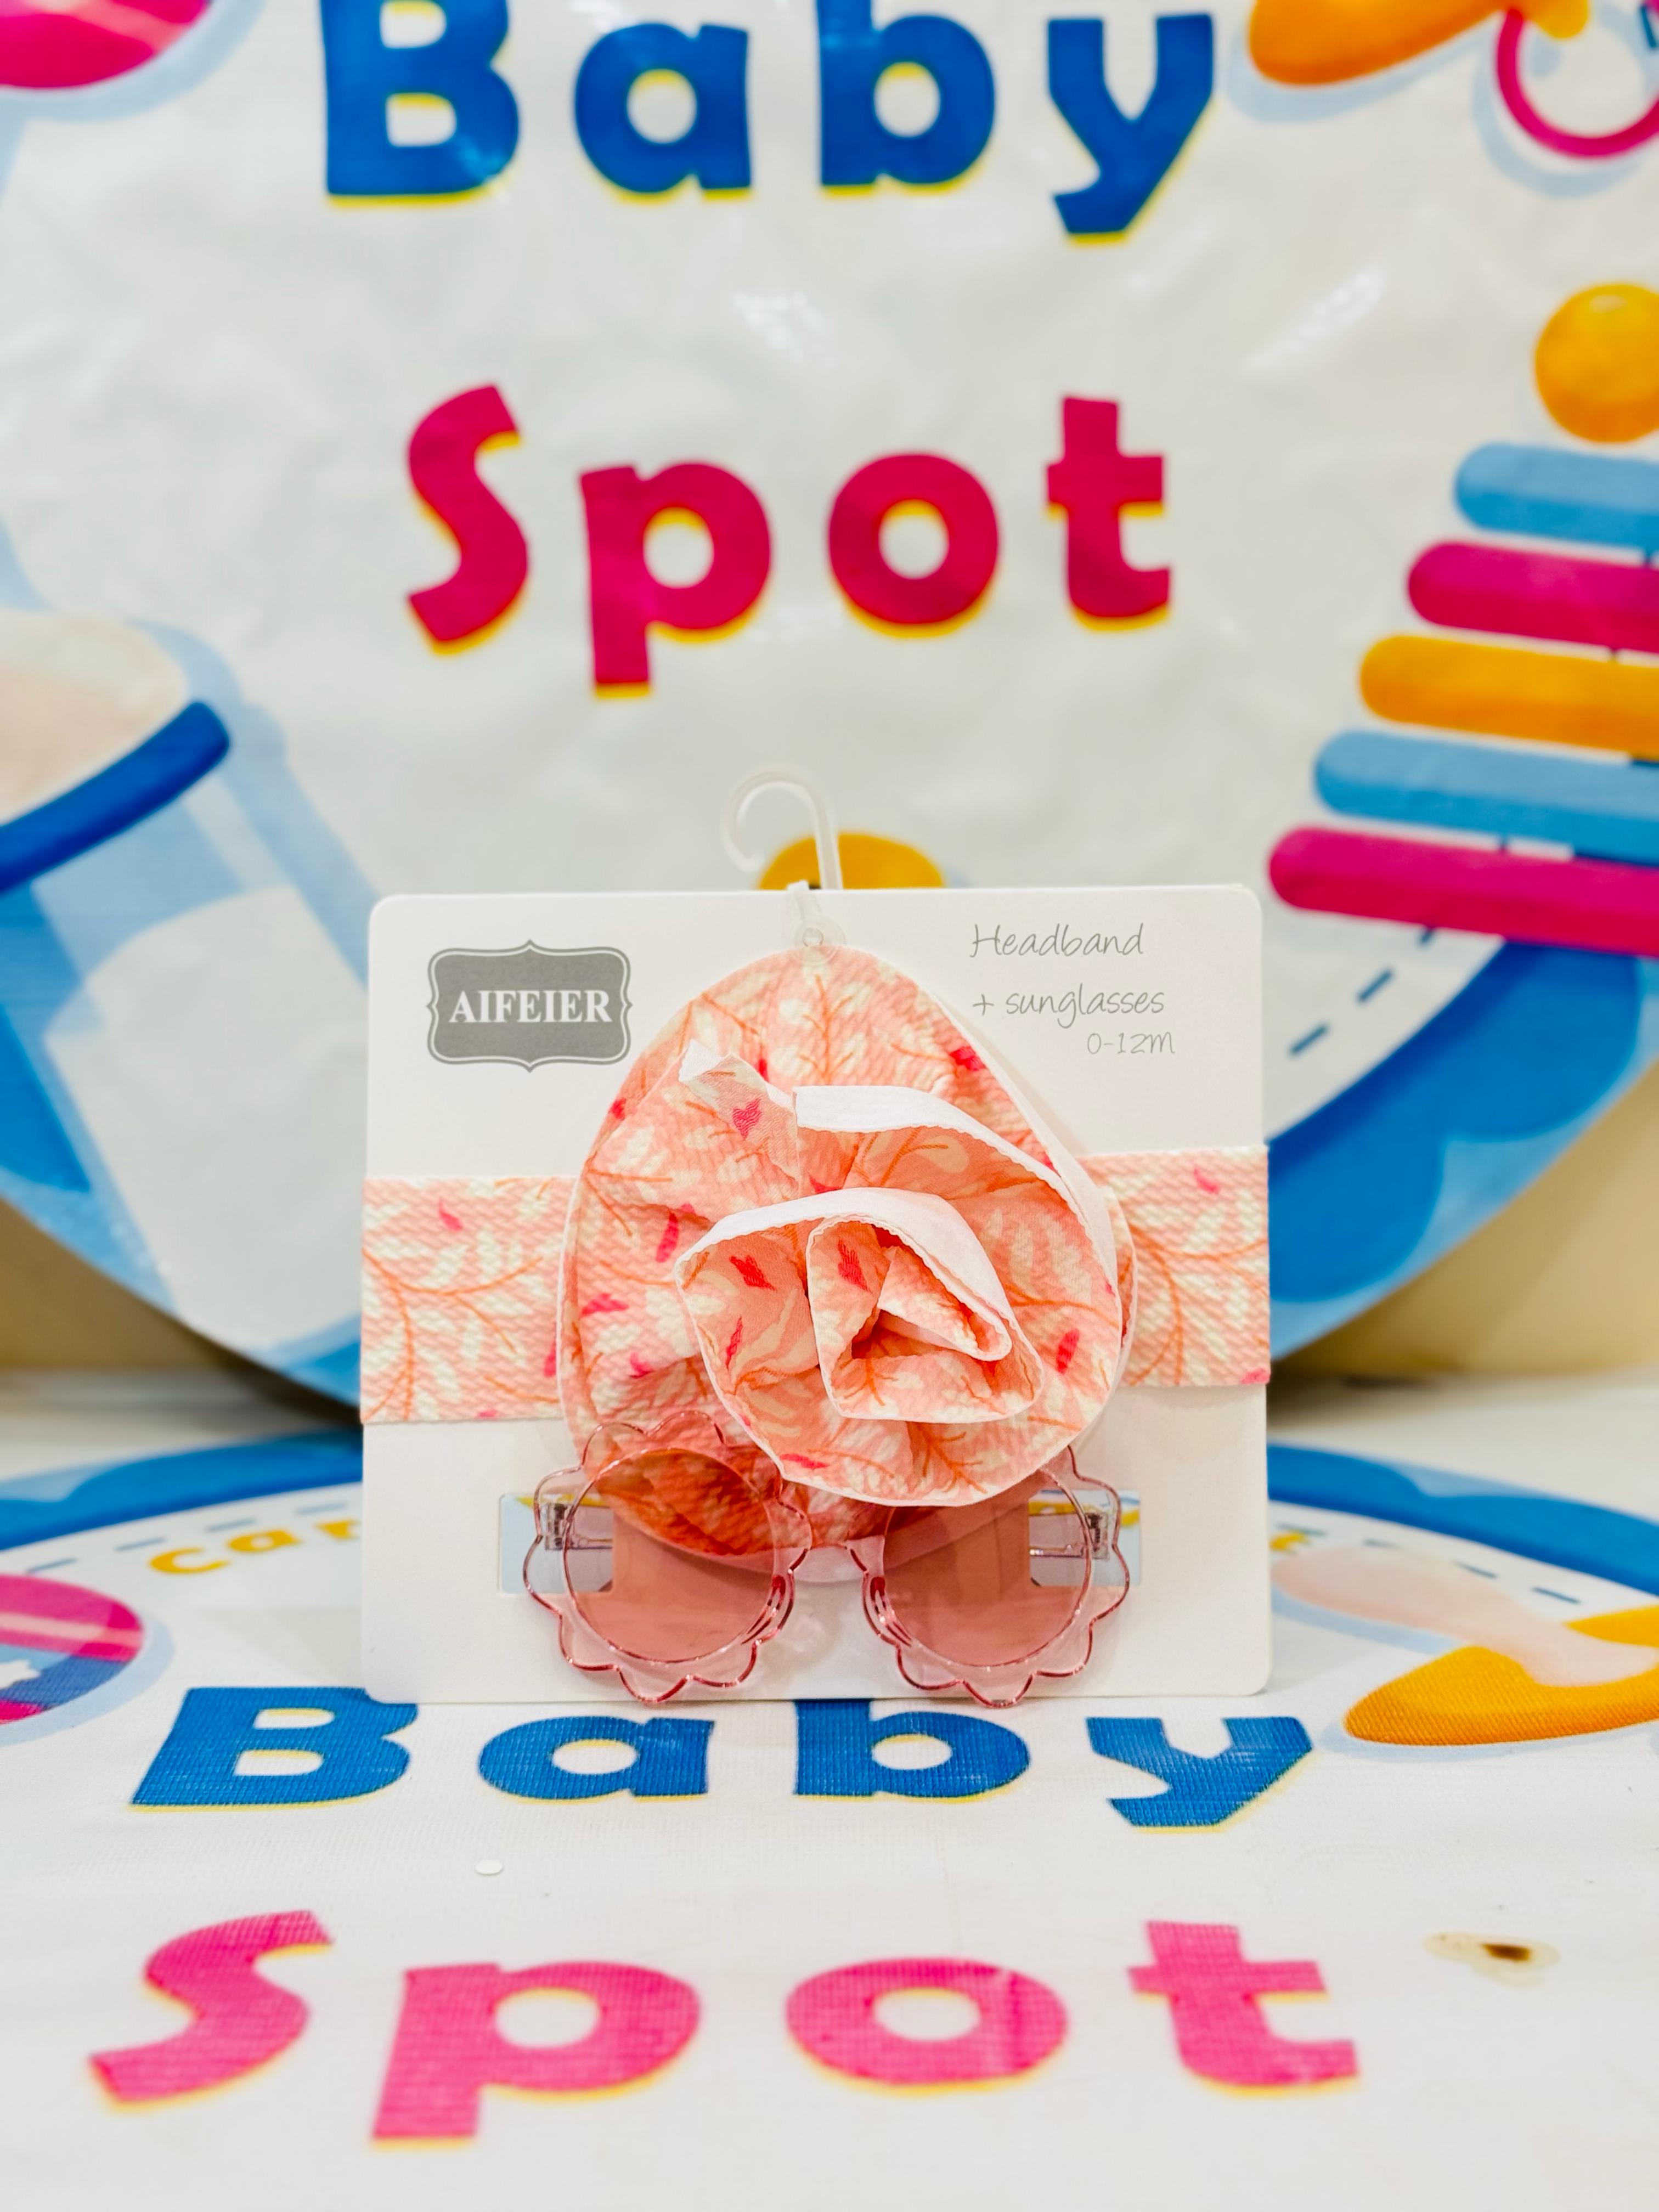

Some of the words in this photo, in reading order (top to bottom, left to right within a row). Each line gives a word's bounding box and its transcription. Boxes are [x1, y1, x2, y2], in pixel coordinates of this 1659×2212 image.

[318, 0, 1214, 241] Baby
[406, 383, 1172, 698] Spot
[449, 990, 612, 1023] AIFEIER
[969, 922, 1144, 958] Headband
[1006, 983, 1165, 1029] sunglasses
[131, 1687, 1312, 1832] Baby
[89, 1910, 1358, 2146] Spot
